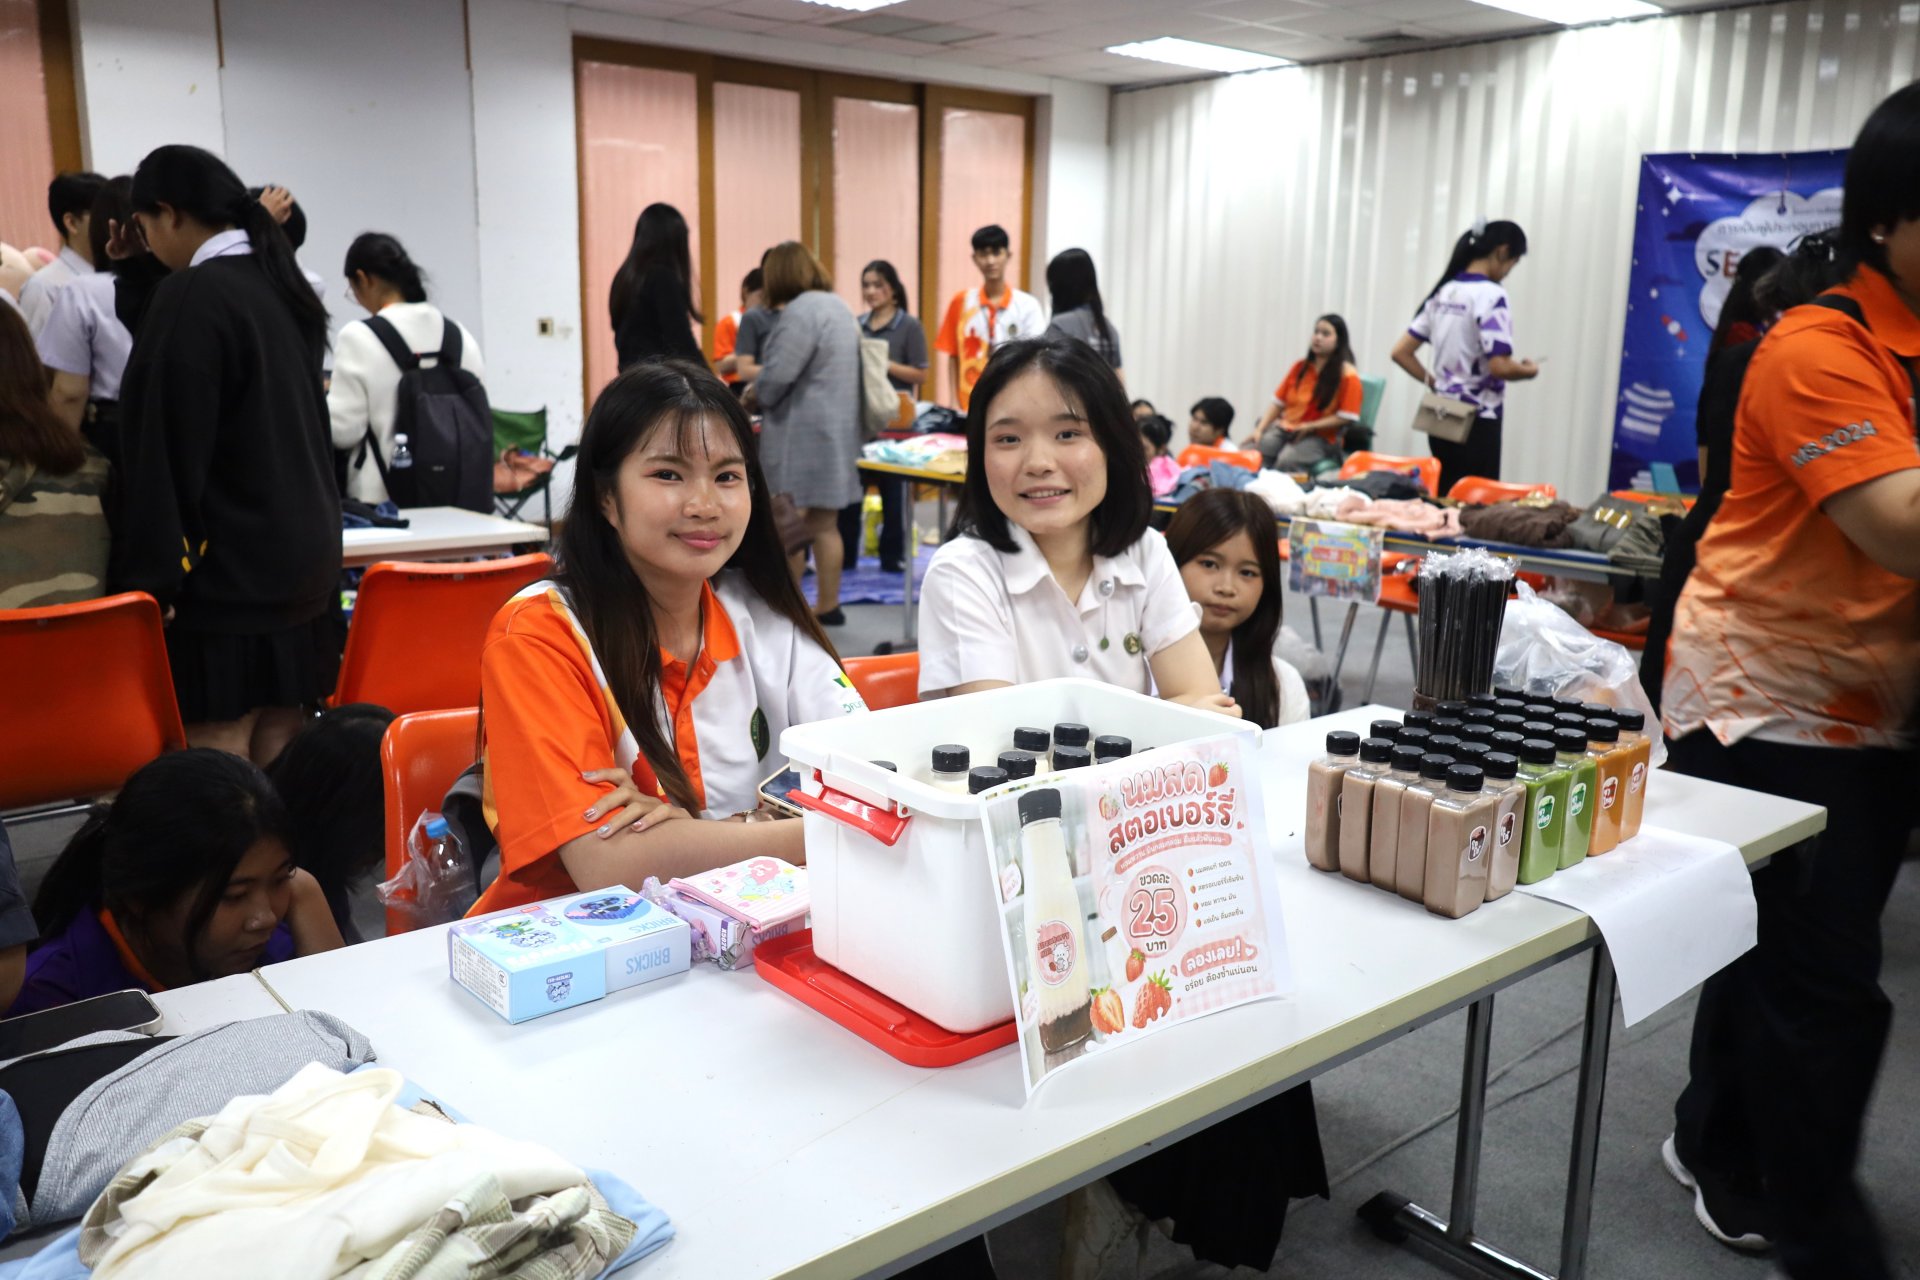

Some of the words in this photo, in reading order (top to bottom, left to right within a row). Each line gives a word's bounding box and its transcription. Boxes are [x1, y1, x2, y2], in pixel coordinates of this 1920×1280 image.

[1121, 761, 1206, 808] นมสด
[1109, 788, 1235, 854] สตอเบอร์รี่
[1140, 873, 1170, 886] ขวดละ
[631, 917, 678, 934] BRICKS
[1129, 888, 1177, 938] 25
[1146, 941, 1167, 952] บาท
[1186, 938, 1242, 972] ลองเลย!
[625, 947, 671, 975] BRICKS
[1184, 977, 1204, 992] อร่อย
[1206, 964, 1258, 983] ต้องซ้ำแน่นอน
